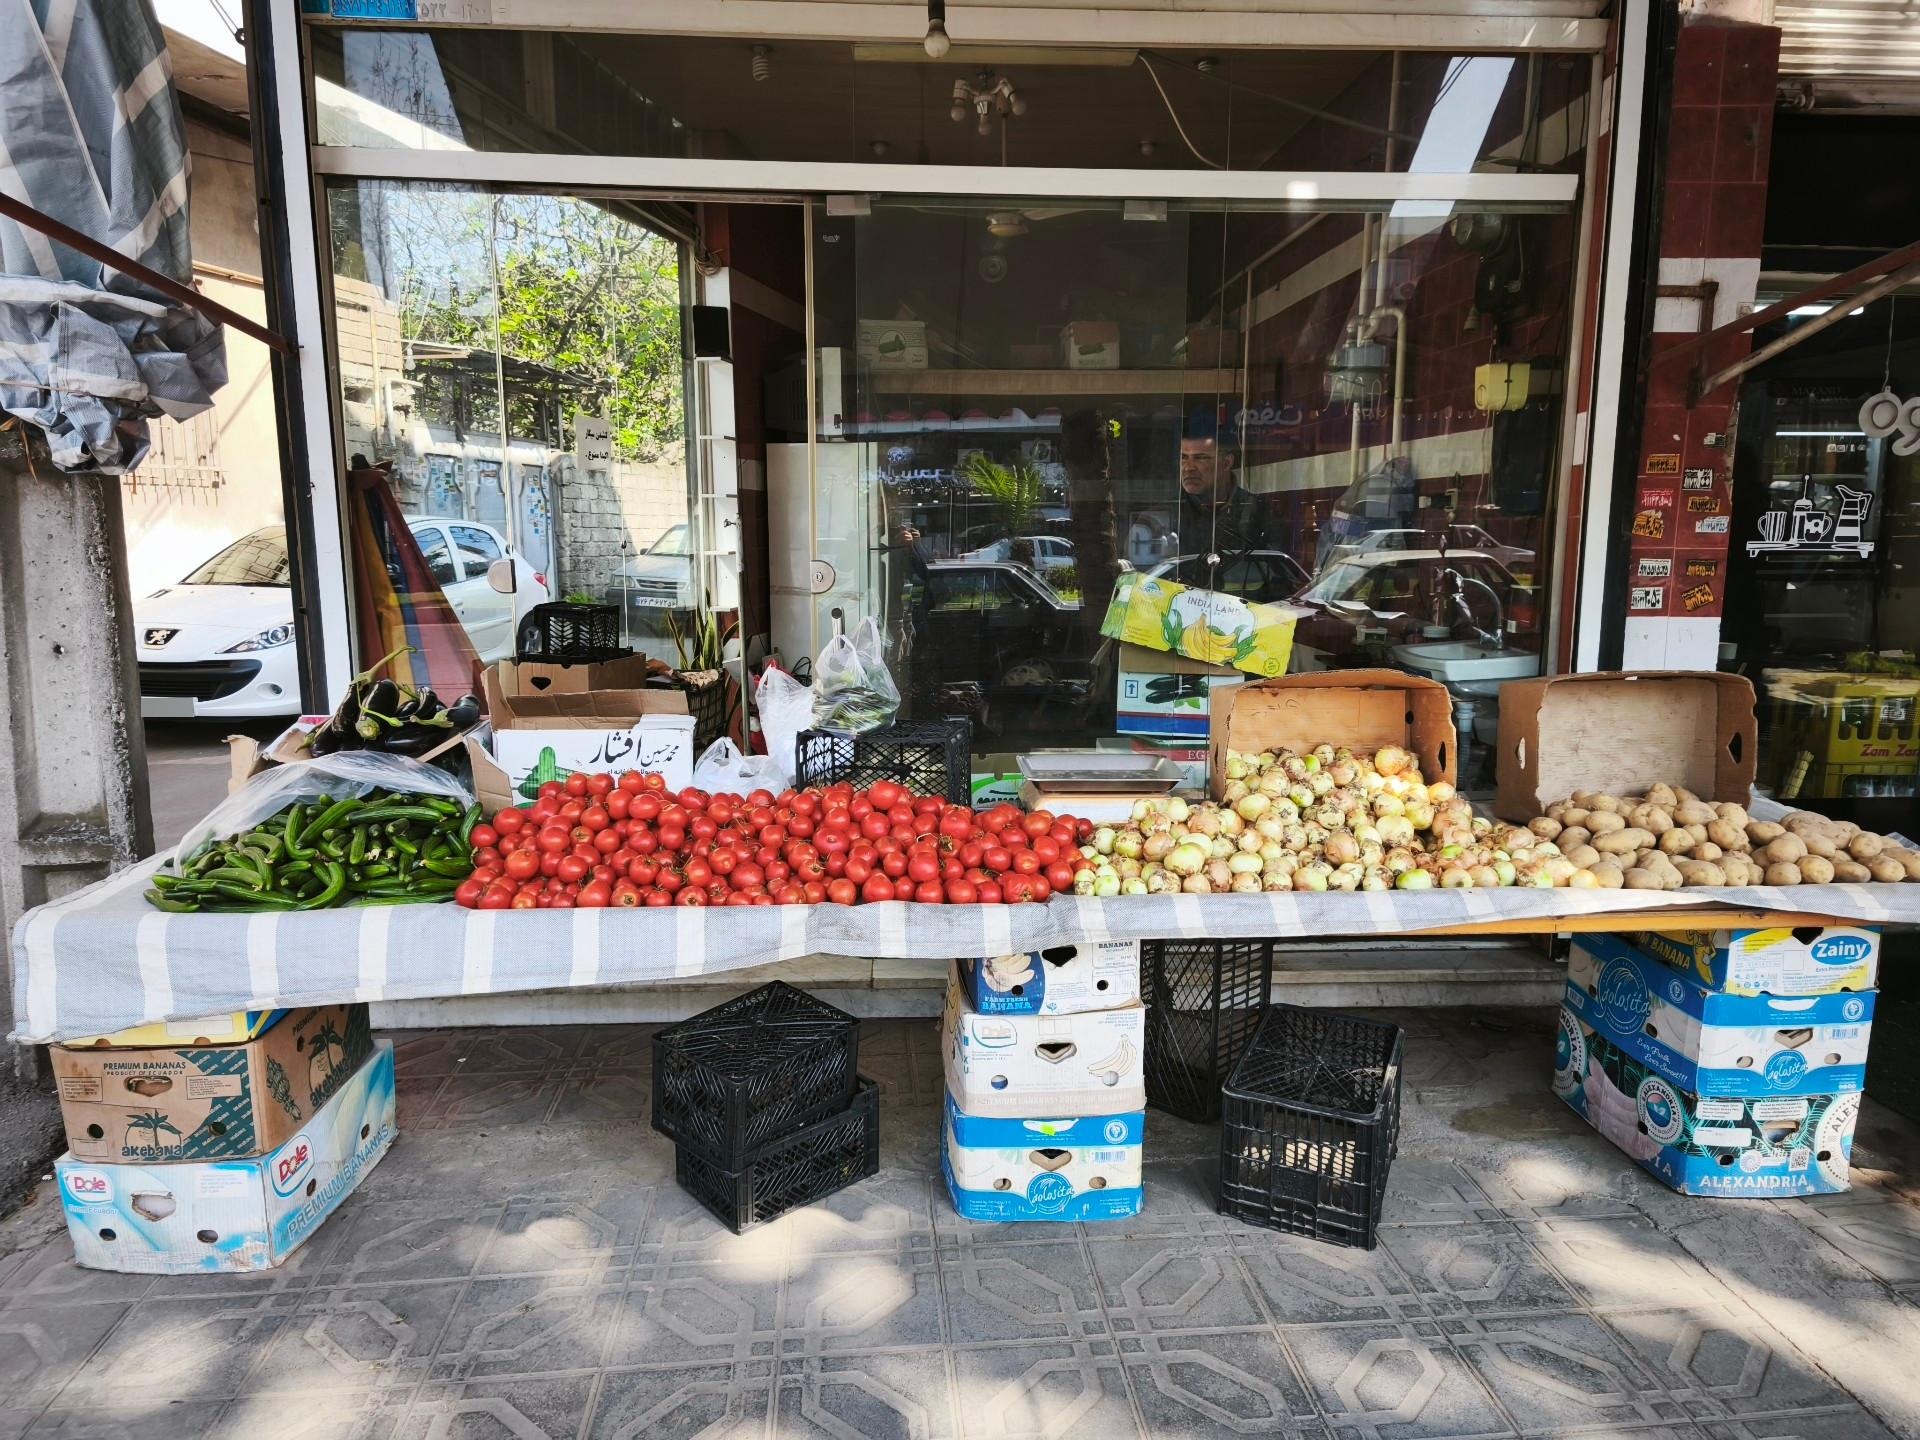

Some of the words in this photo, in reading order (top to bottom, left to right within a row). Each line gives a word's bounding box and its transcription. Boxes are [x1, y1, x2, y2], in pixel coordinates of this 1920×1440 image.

[1187, 596, 1212, 610] INDIA
[1215, 603, 1241, 616] LAND
[588, 730, 643, 764] افشار
[1860, 743, 1889, 757] Zam
[1098, 941, 1133, 949] BANANAS
[1816, 940, 1868, 960] Zainy
[1651, 938, 1691, 970] BANANA
[981, 1001, 1033, 1011] BANANA
[103, 1062, 141, 1071] PREMIUM
[143, 1061, 186, 1070] BANANAS
[278, 1143, 308, 1183] Dole
[74, 1176, 106, 1191] Dole
[288, 1174, 346, 1240] PREMIUM
[343, 1123, 389, 1183] BANANAS
[1698, 1174, 1808, 1188] ALEXANDRIA
